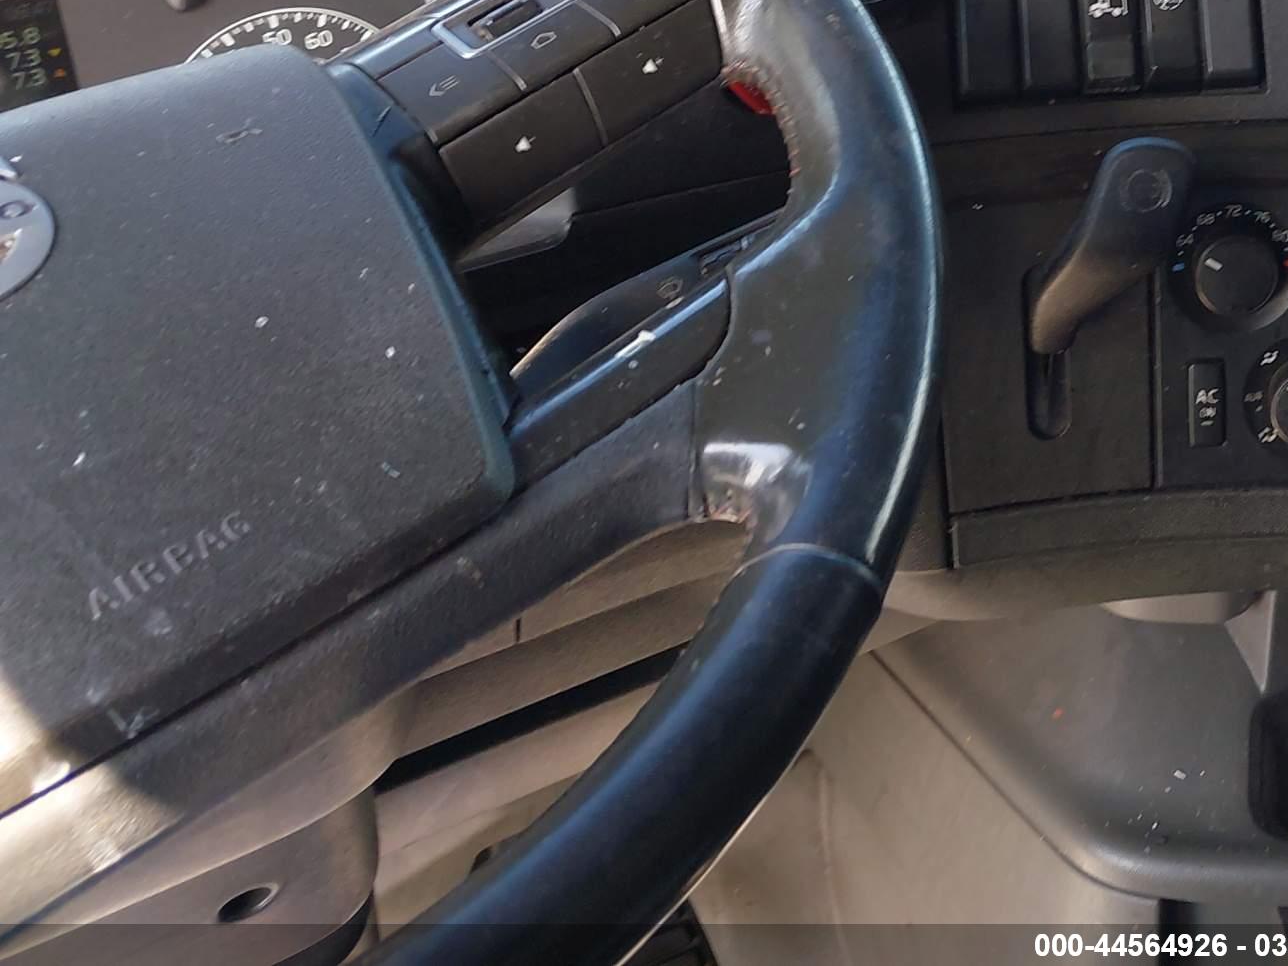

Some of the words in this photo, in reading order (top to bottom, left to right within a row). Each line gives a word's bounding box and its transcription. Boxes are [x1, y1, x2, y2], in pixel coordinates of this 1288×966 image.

[262, 29, 292, 45] 50
[304, 30, 333, 49] 60
[4, 48, 42, 71] 73
[11, 67, 48, 90] 73
[1175, 233, 1194, 247] 64
[1225, 204, 1244, 217] 72
[1254, 211, 1272, 224] 76
[1195, 388, 1219, 404] AC
[84, 511, 252, 621] AIRBAG
